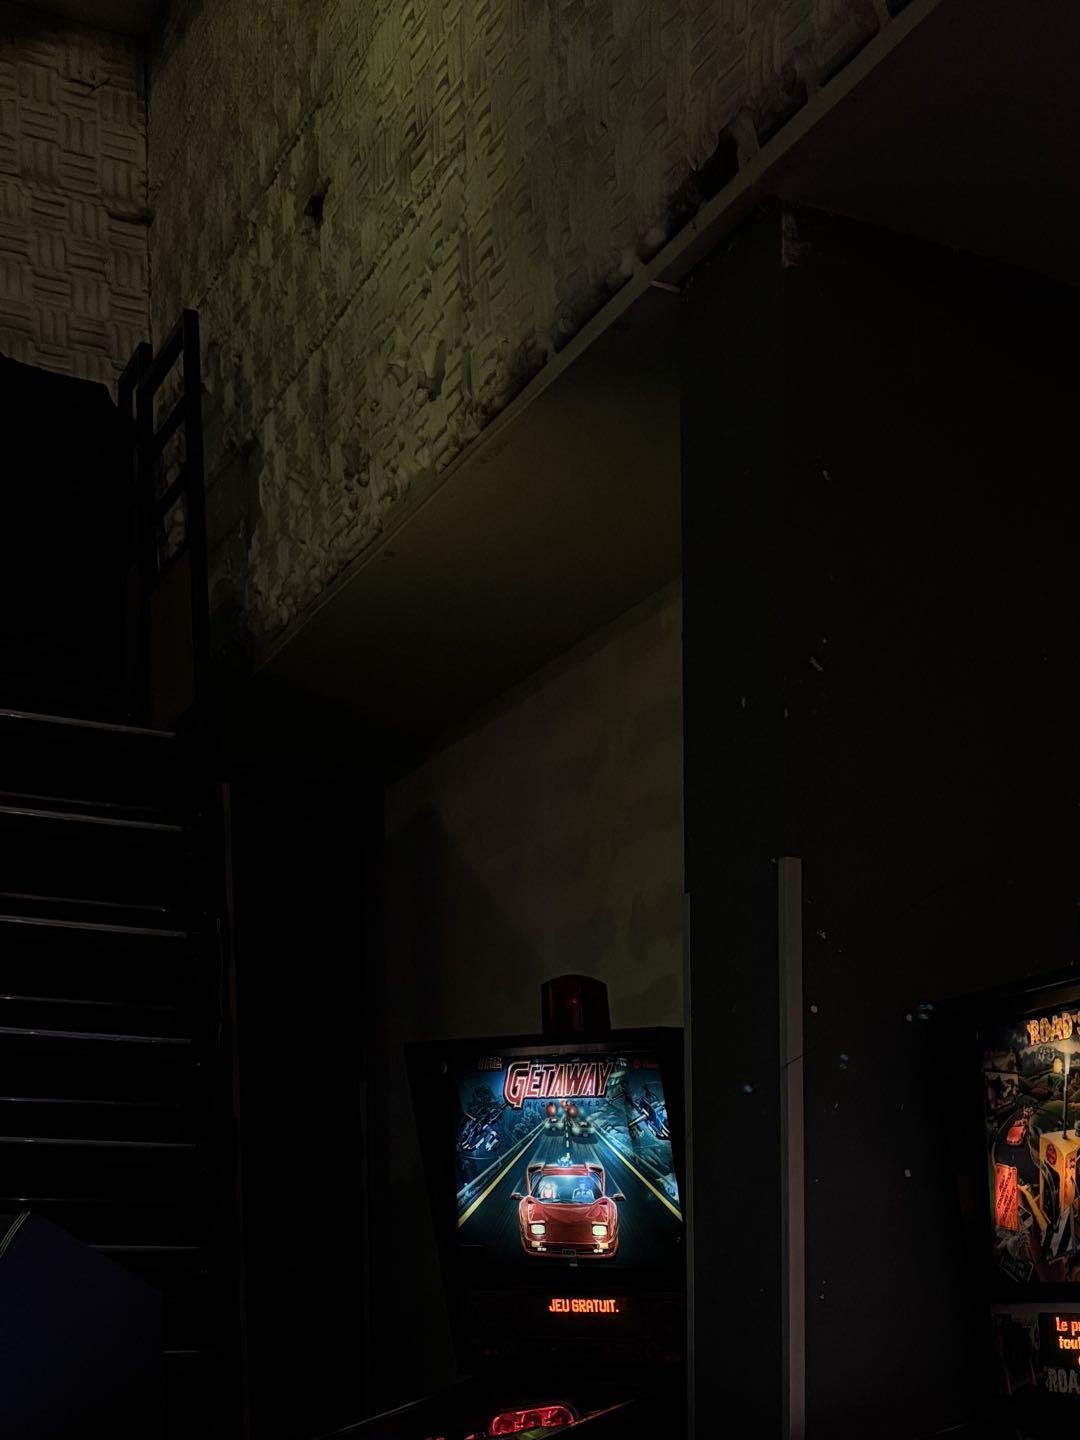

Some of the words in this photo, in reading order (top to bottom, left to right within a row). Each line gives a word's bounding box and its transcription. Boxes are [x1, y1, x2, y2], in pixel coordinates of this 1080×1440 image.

[1026, 1012, 1073, 1046] ROAD
[504, 1060, 614, 1109] GETAWAY
[549, 1298, 570, 1313] JEU
[571, 1298, 619, 1313] GRATUIT.
